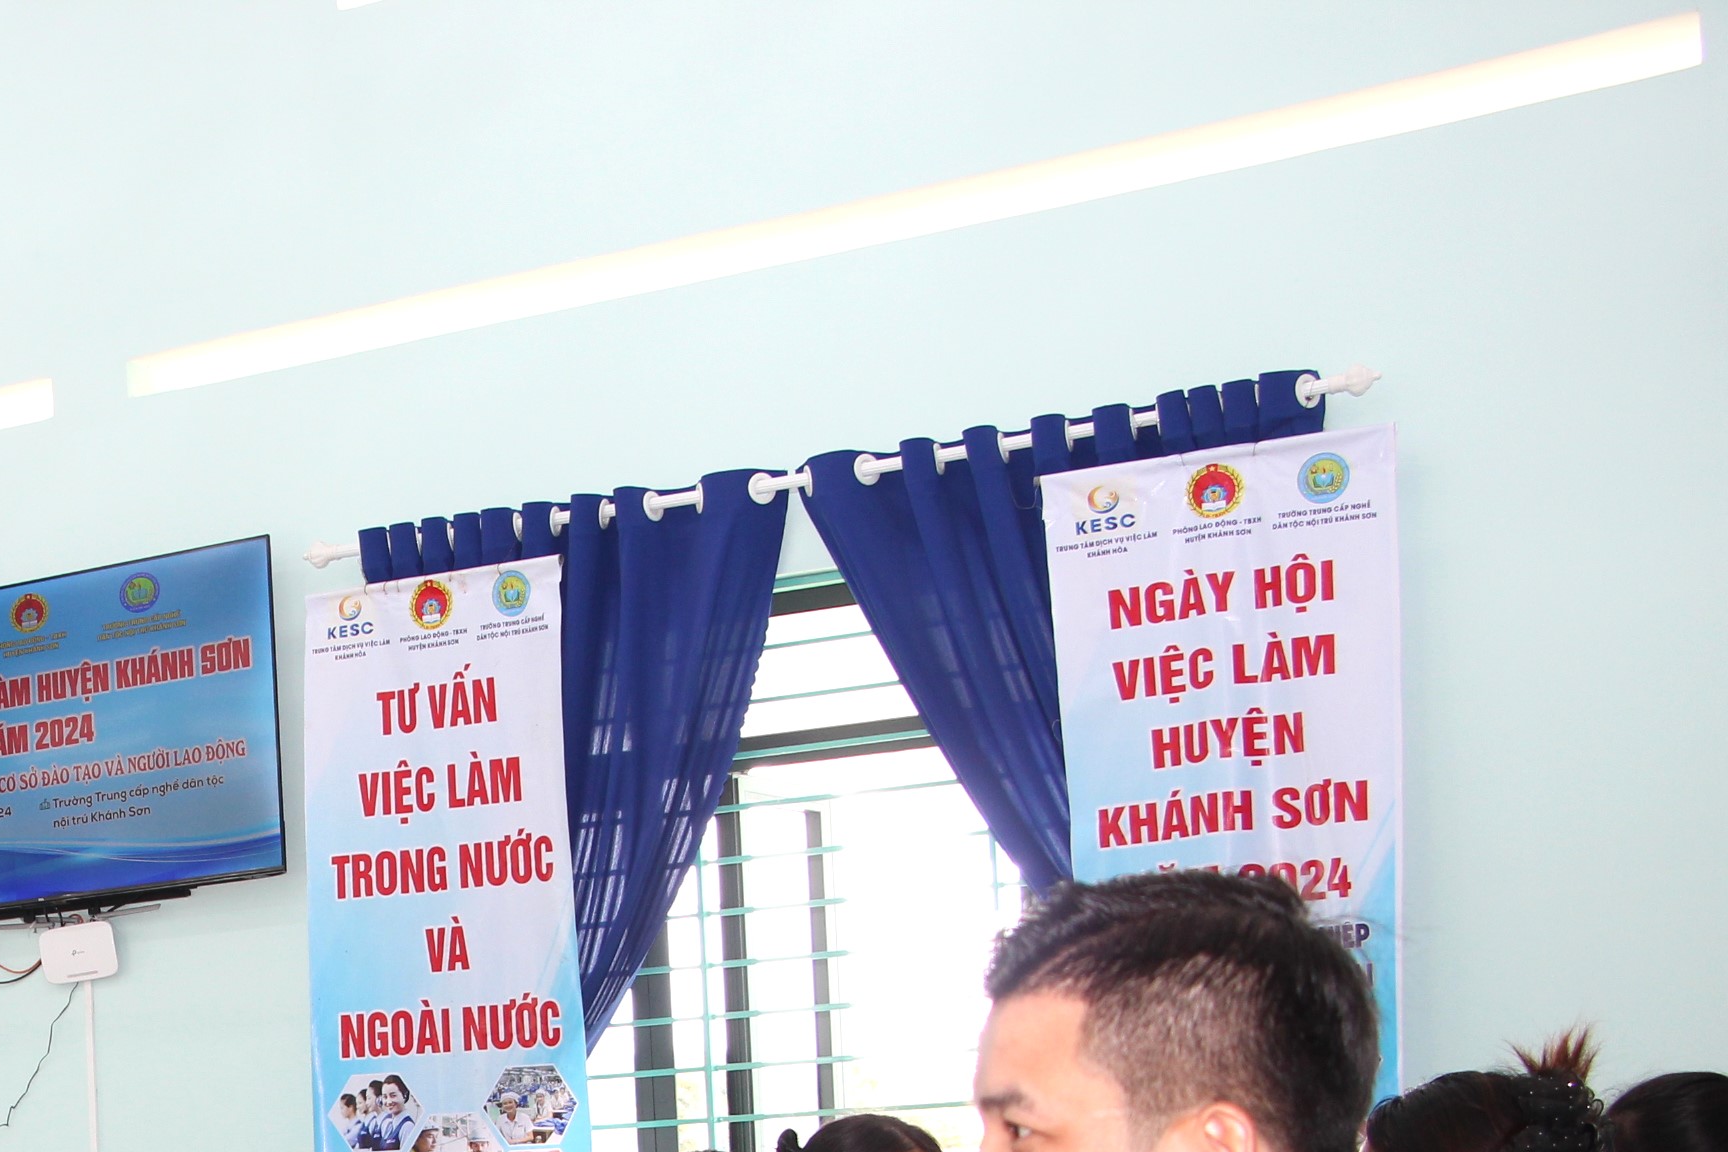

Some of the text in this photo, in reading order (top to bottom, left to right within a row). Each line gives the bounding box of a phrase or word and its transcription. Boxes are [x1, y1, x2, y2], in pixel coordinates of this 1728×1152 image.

[1076, 514, 1136, 536] KESC
[1200, 522, 1212, 530] LAO
[1309, 506, 1332, 515] TRUNG
[1056, 544, 1078, 552] TRUNG
[1108, 553, 1334, 630] NGÀY HỘI
[327, 622, 374, 640] KESC
[421, 632, 432, 640] LAO
[502, 618, 520, 626] TRUNG
[37, 661, 110, 702] HUYỆN
[116, 648, 194, 689] KHÁNH
[201, 637, 250, 675] SƠN
[312, 647, 329, 655] TRUNG
[1113, 632, 1336, 704] VIỆC LÀM
[376, 663, 497, 736] TƯ VẤN
[34, 714, 94, 750] 2024
[1150, 708, 1305, 769] HUYỆN
[20, 767, 38, 790] SỞ
[42, 765, 70, 787] ĐÀO
[74, 762, 101, 784] TẠO
[105, 754, 124, 776] VÀ
[128, 748, 170, 774] NGƯỜI
[174, 747, 202, 766] LAO
[205, 739, 246, 765] ĐỘNG
[52, 775, 224, 809] Trường Trung cấp nghề dân tộc
[358, 751, 522, 824] VIỆC LÀM
[53, 806, 150, 829] nội trú Khánh Sơn
[1098, 778, 1368, 849] KHÁNH SƠN
[331, 828, 554, 900] TRONG NƯỚC
[425, 916, 470, 972] VÀ
[340, 992, 562, 1058] NGOÀI NƯỚC
